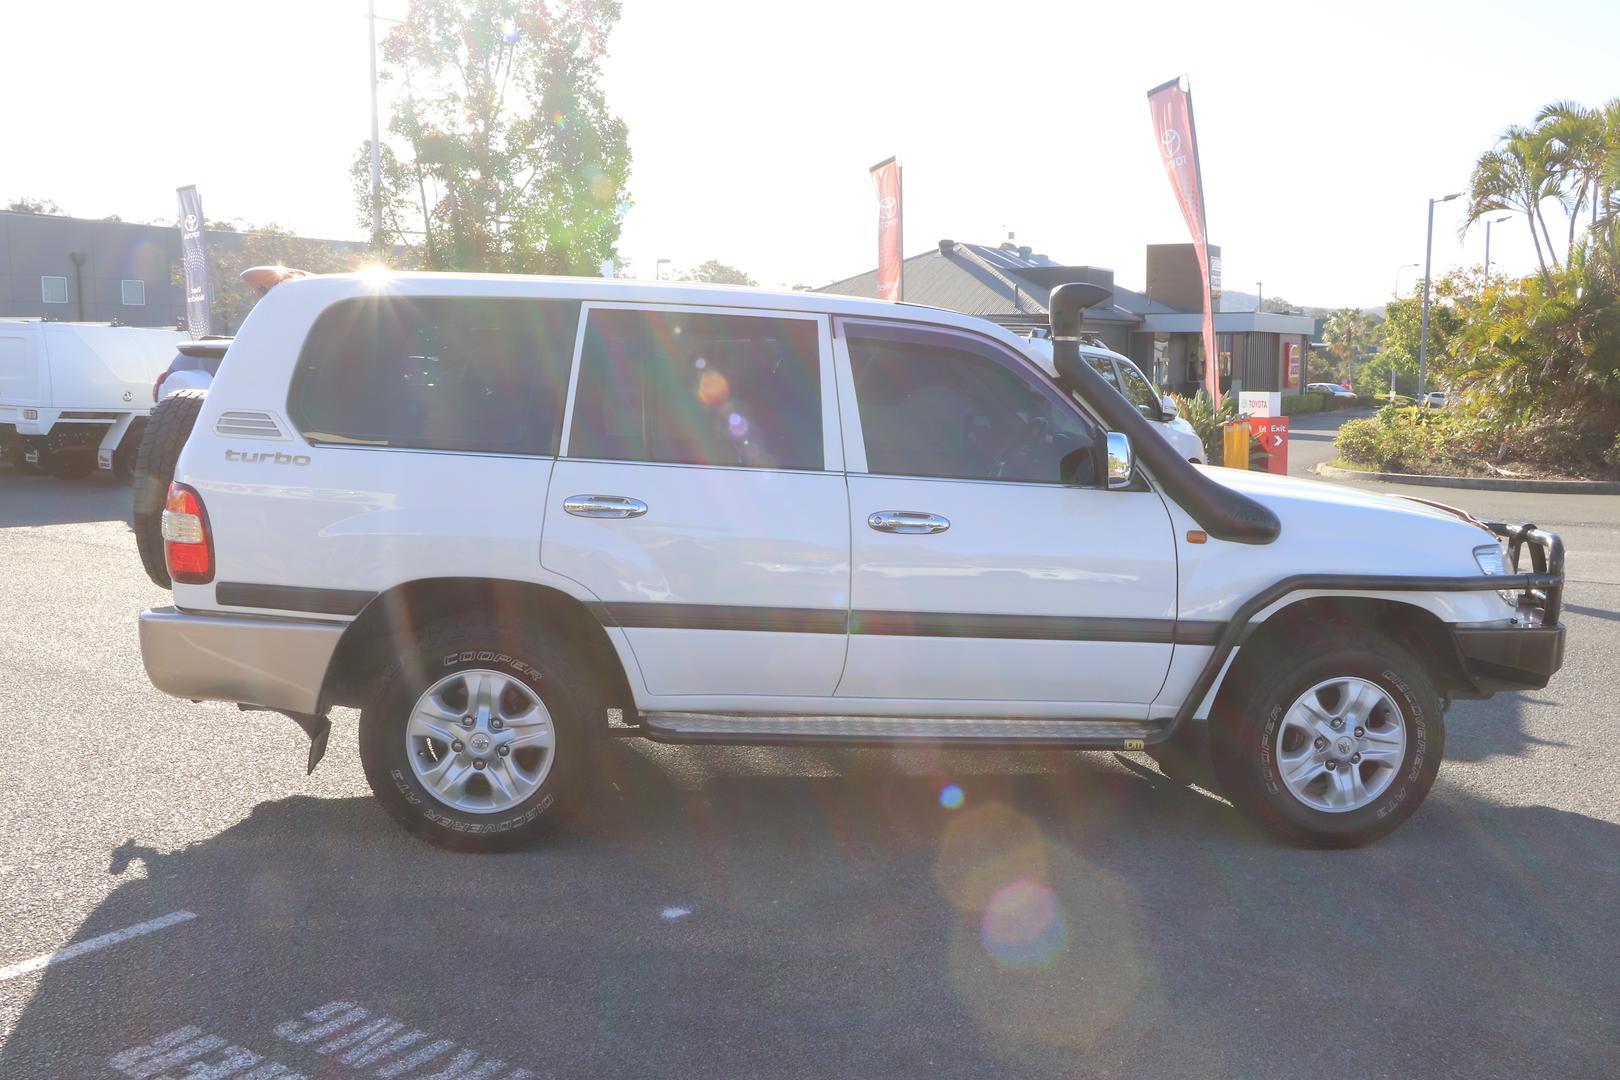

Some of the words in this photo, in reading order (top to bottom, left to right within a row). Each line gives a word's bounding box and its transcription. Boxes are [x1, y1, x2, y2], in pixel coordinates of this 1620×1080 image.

[1248, 400, 1267, 409] TOYOTA
[225, 449, 311, 467] turbo
[443, 650, 543, 681] COOPER
[1382, 670, 1427, 782] DISCOVERER
[1261, 704, 1283, 795] COOPER
[423, 793, 554, 833] DISCOVERER
